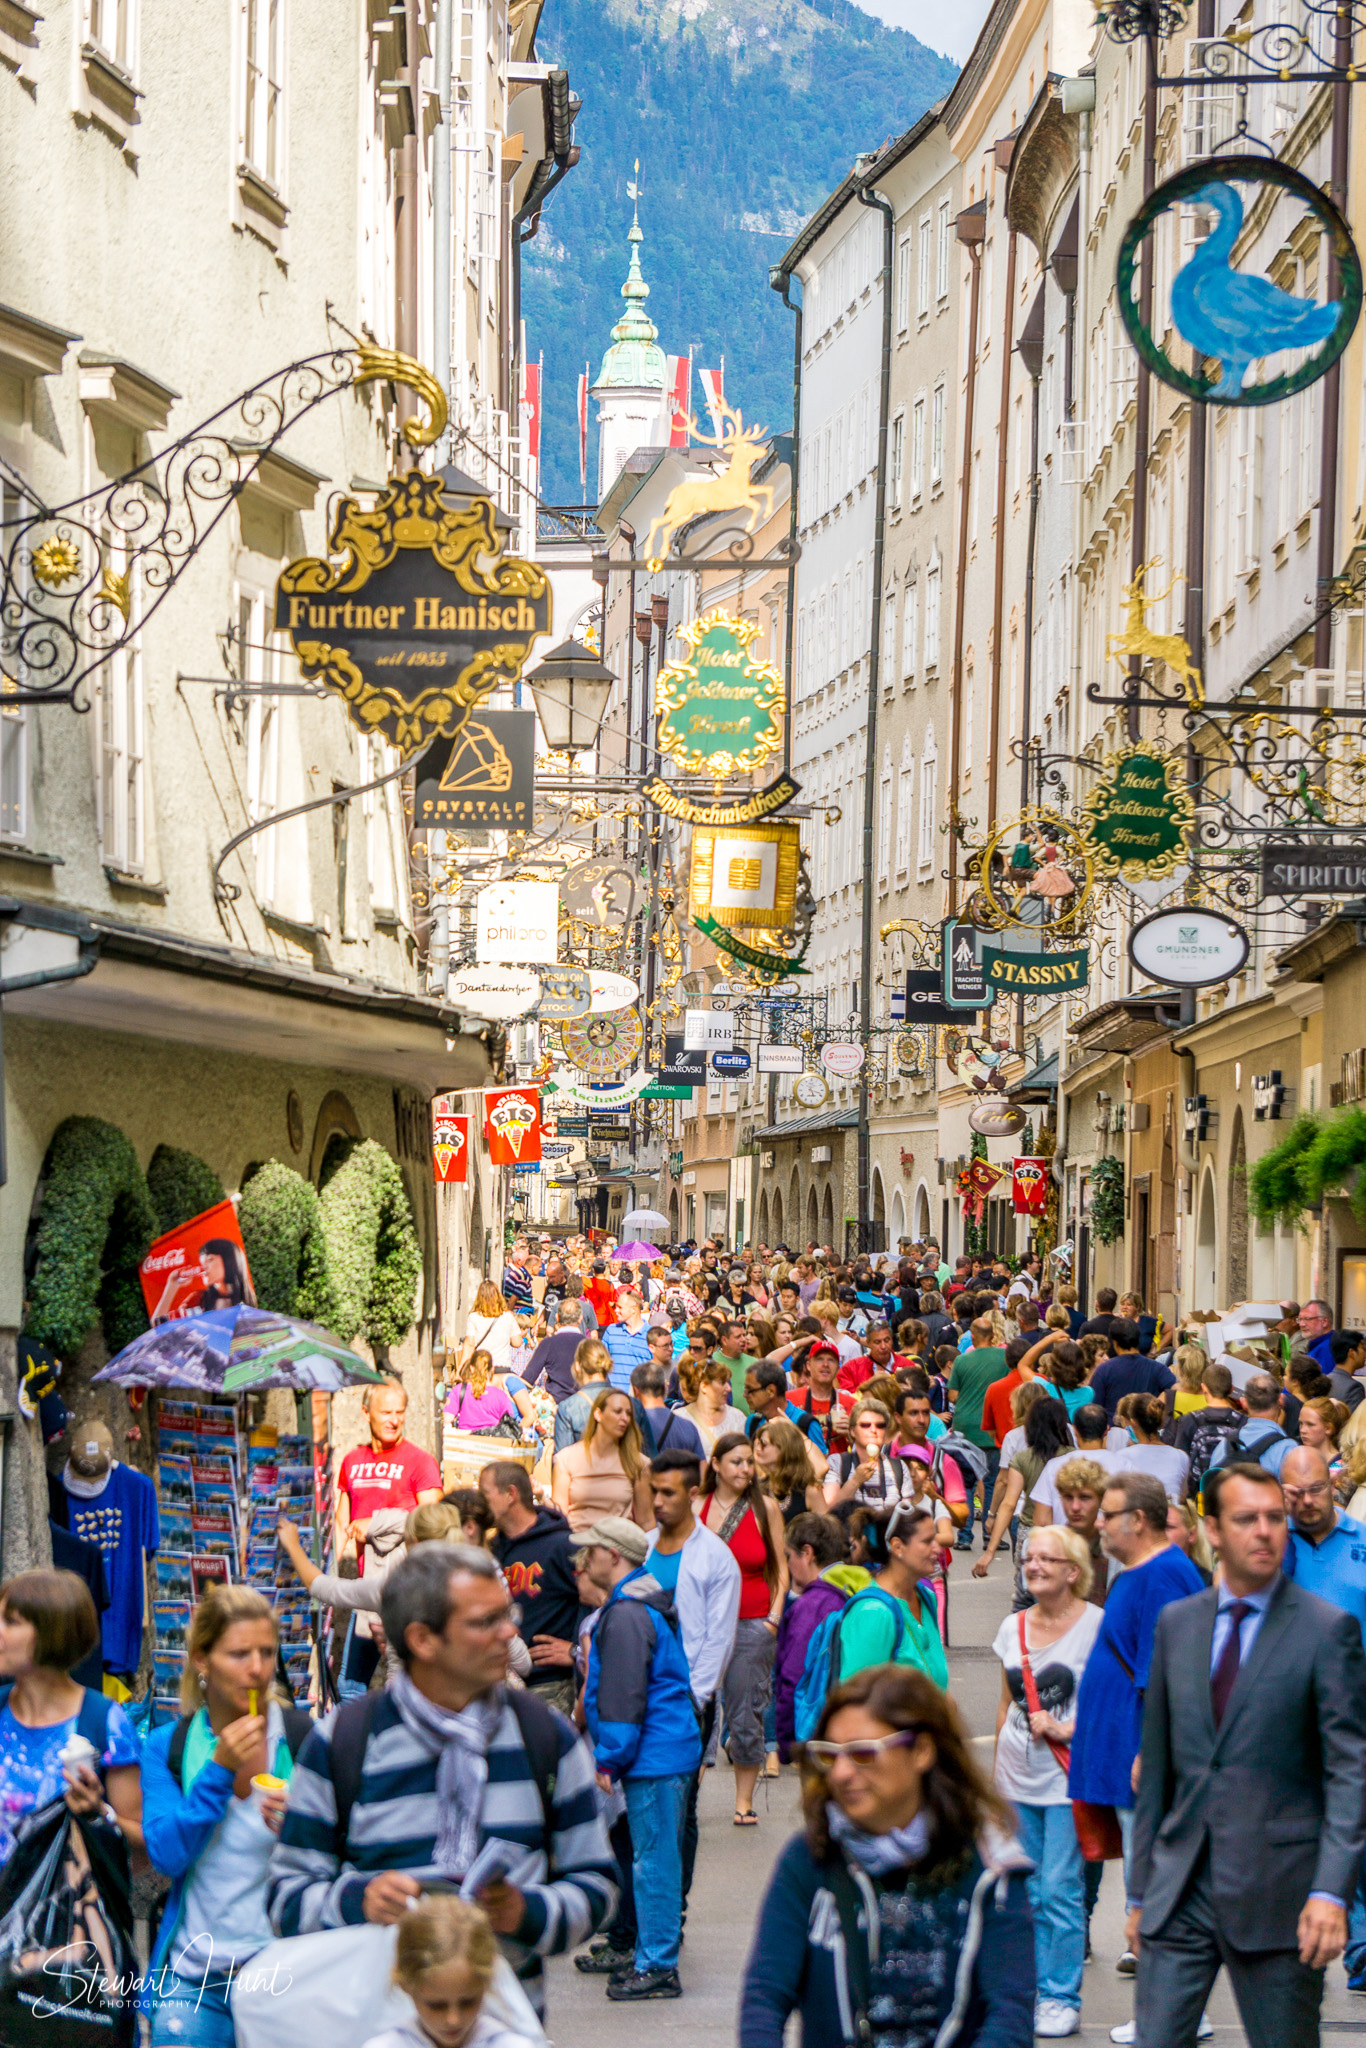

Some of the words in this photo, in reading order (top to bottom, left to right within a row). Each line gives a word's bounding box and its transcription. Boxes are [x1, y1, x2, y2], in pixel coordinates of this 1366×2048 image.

[288, 596, 406, 629] Furtner
[413, 597, 536, 631] Hanisch
[375, 651, 402, 667] seit
[406, 651, 448, 668] 1955
[695, 647, 746, 668] Hotel
[686, 680, 759, 700] Goldener
[687, 714, 752, 735] Hirsch
[1120, 772, 1163, 790] Hotel
[642, 776, 794, 825] Kupferschmiedhaus
[1107, 799, 1170, 818] Goldener
[1110, 827, 1162, 847] Hirsch
[576, 906, 595, 916] seit
[487, 925, 547, 944] philoro
[709, 926, 789, 971] DENKSTEIN
[1156, 945, 1221, 954] GMUNDNER
[990, 959, 1080, 985] STASSNY
[456, 982, 532, 996] Dantendorfer
[540, 1003, 575, 1012] STOCK
[708, 1028, 732, 1039] IRB
[663, 1064, 702, 1074] SWAROVSKI
[716, 1056, 748, 1066] Berlitz
[496, 1093, 527, 1108] FRISCH
[568, 1087, 637, 1104] Aschauer
[493, 1107, 533, 1127] EIS
[1016, 1168, 1041, 1180] EIS
[349, 1462, 404, 1479] FITCH
